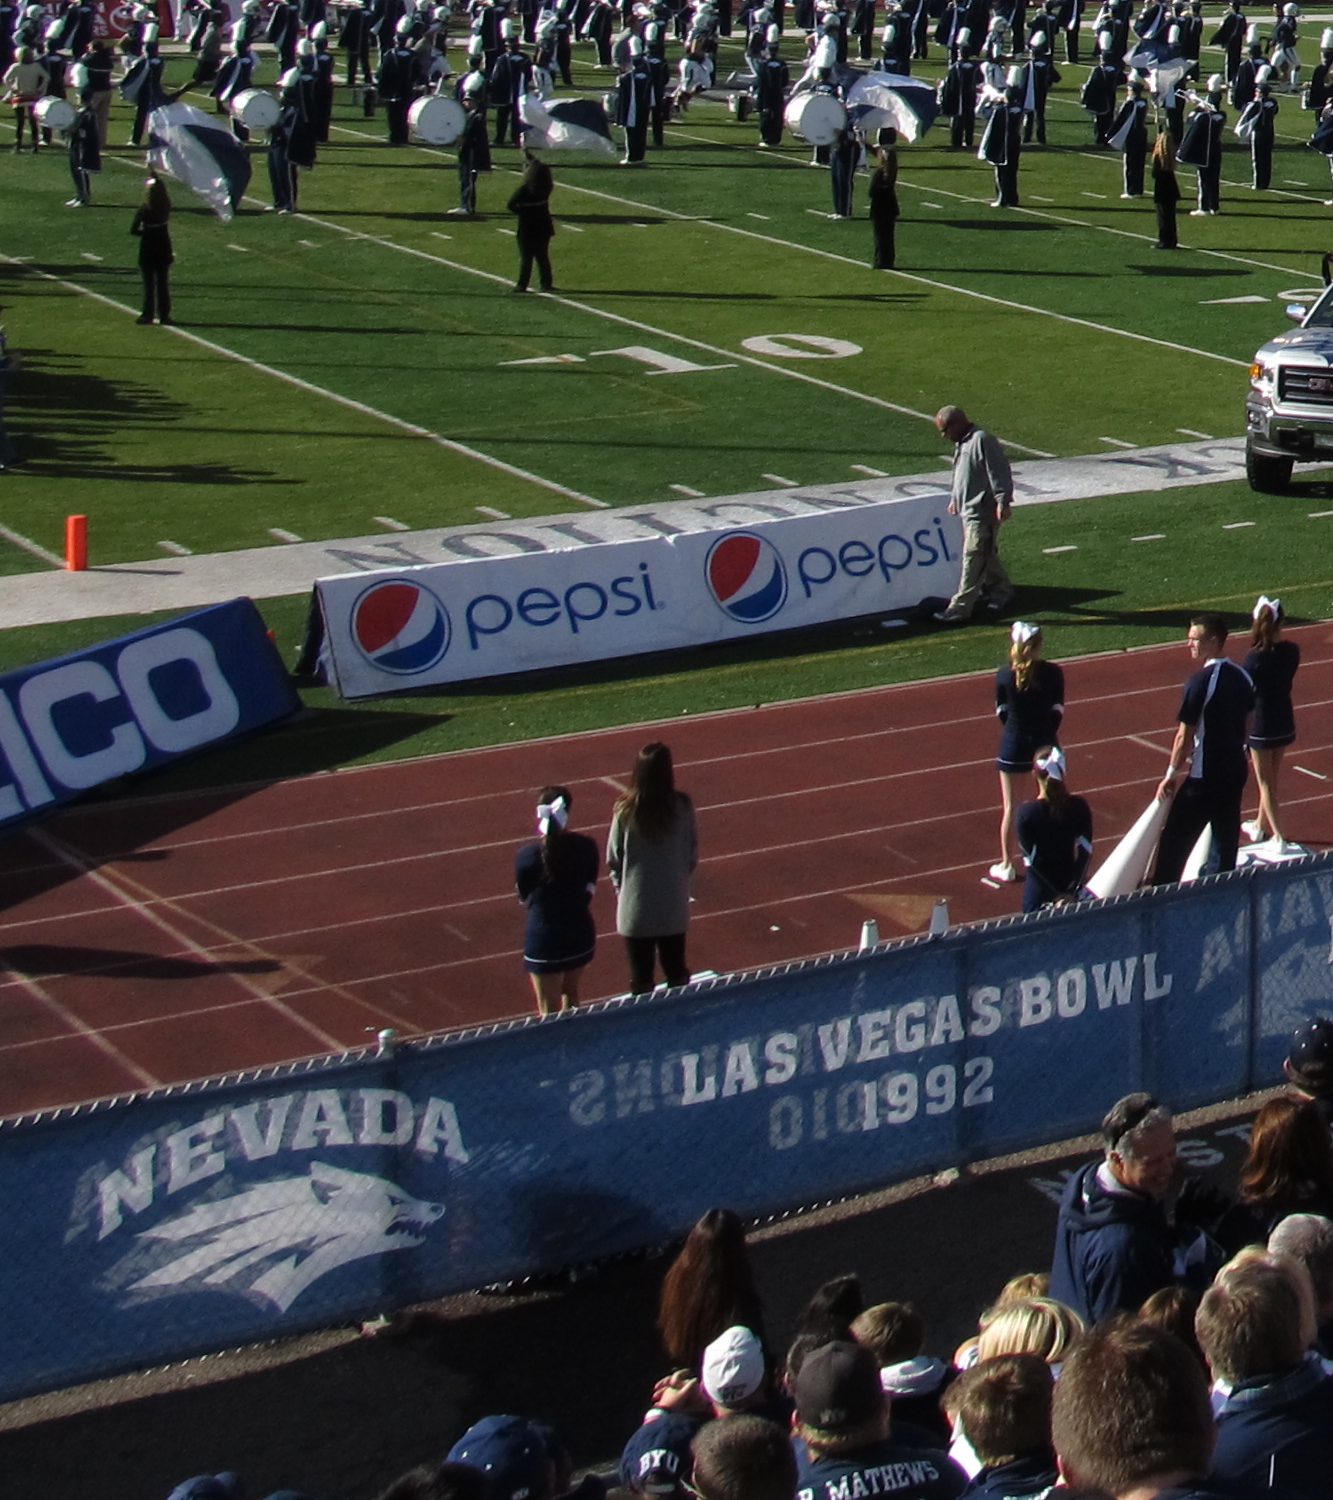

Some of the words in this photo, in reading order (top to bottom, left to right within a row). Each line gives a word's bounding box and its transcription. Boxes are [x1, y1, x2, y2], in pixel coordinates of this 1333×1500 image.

[466, 562, 657, 650] pepsi
[797, 517, 951, 598] pepsi
[0, 627, 240, 822] ICO
[680, 1032, 799, 1106] LAS
[818, 986, 1001, 1072] VEGAS
[1018, 952, 1173, 1028] BOWL
[862, 1056, 996, 1133] 1992
[98, 1087, 470, 1242] NEVADA
[824, 1459, 940, 1500] MATHEWS
